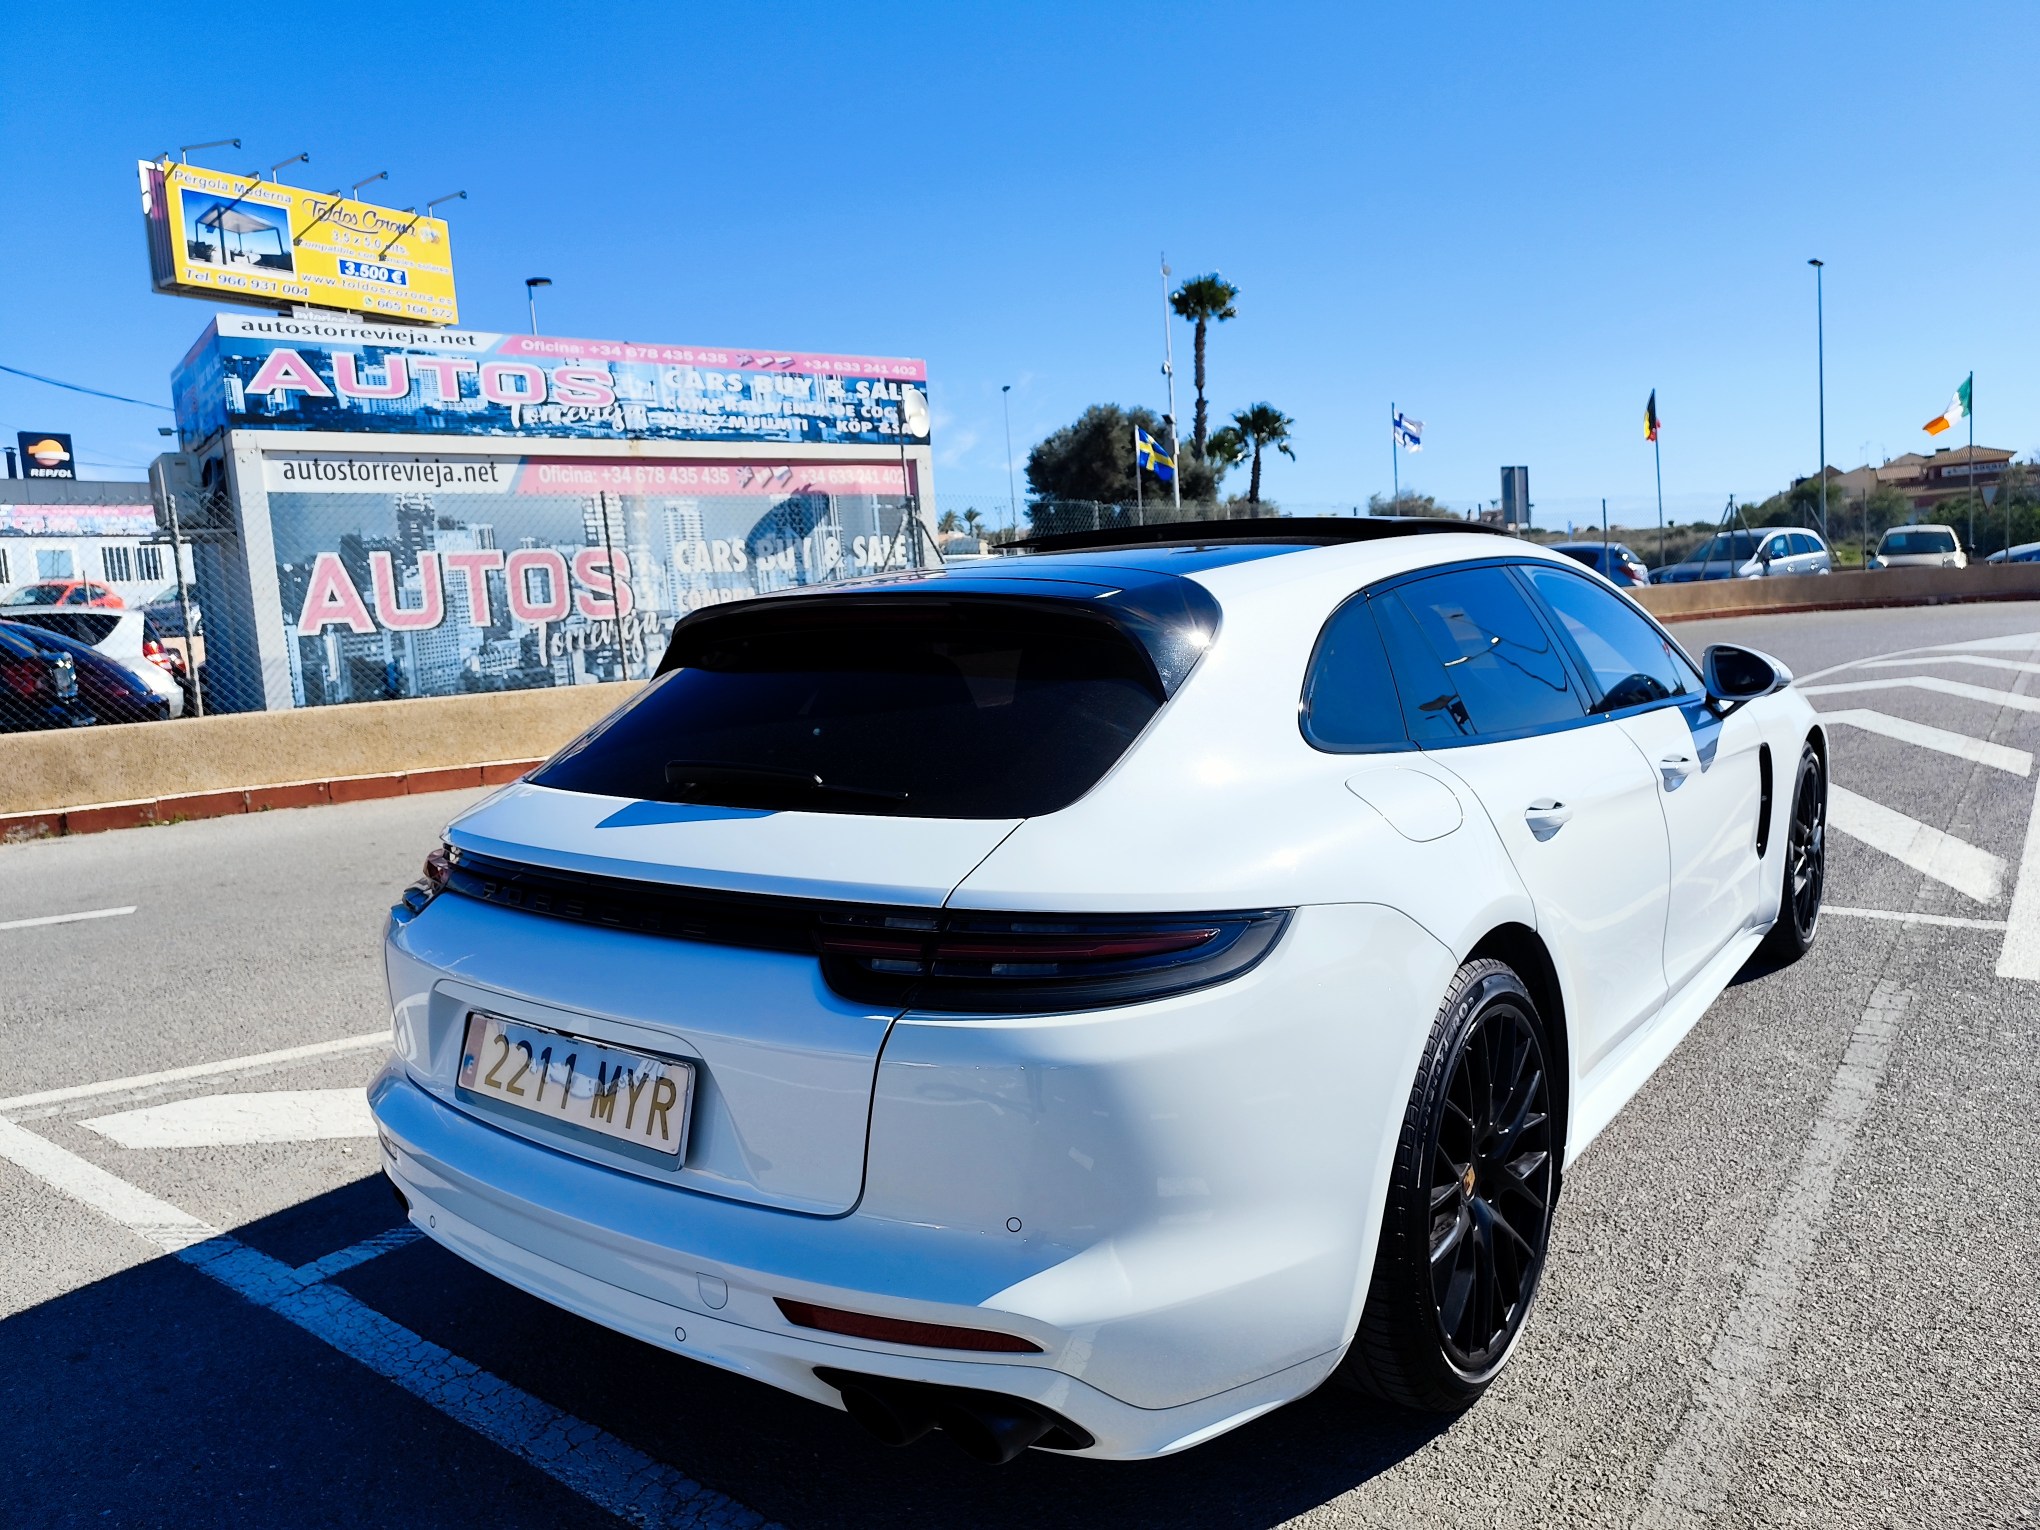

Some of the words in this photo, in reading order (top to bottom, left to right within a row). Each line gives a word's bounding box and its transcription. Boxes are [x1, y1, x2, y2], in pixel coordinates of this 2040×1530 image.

[174, 170, 228, 190] Pérgola
[233, 182, 292, 204] Moderna
[302, 198, 358, 226] Toldos
[382, 256, 416, 269] aneles
[218, 273, 246, 287] 966
[251, 279, 277, 291] 931
[282, 283, 309, 296] 004
[391, 270, 404, 284] €
[406, 304, 427, 315] 166
[241, 320, 477, 346] autostorrevieja.net
[521, 339, 584, 355] Oficina:
[589, 344, 621, 357] +34
[625, 345, 658, 359] 678
[662, 348, 694, 361] 435
[698, 351, 729, 364] 435
[244, 347, 617, 408] AUTOS
[803, 359, 830, 371] +34
[834, 361, 861, 372] 633
[864, 363, 889, 374] 241
[891, 365, 917, 376] 402
[664, 370, 744, 392] CARS
[753, 374, 813, 397] BUY
[833, 404, 857, 418] DE
[836, 417, 873, 433] KÖP
[30, 468, 73, 478] REPSOL
[283, 459, 499, 487] autostorrevieja.net
[539, 465, 598, 484] Oficina:
[601, 467, 632, 484] +34
[635, 467, 665, 484] 678
[669, 467, 698, 485] 435
[701, 467, 731, 485] 435
[799, 469, 825, 484] +34
[829, 469, 854, 484] 633
[854, 469, 880, 485] 241
[674, 538, 748, 573] CARS
[755, 537, 813, 571] BUY
[824, 535, 845, 568] &
[852, 534, 908, 568] SALE
[298, 547, 635, 637] AUTOS
[484, 1033, 577, 1110] 2211
[589, 1060, 678, 1141] MYR
